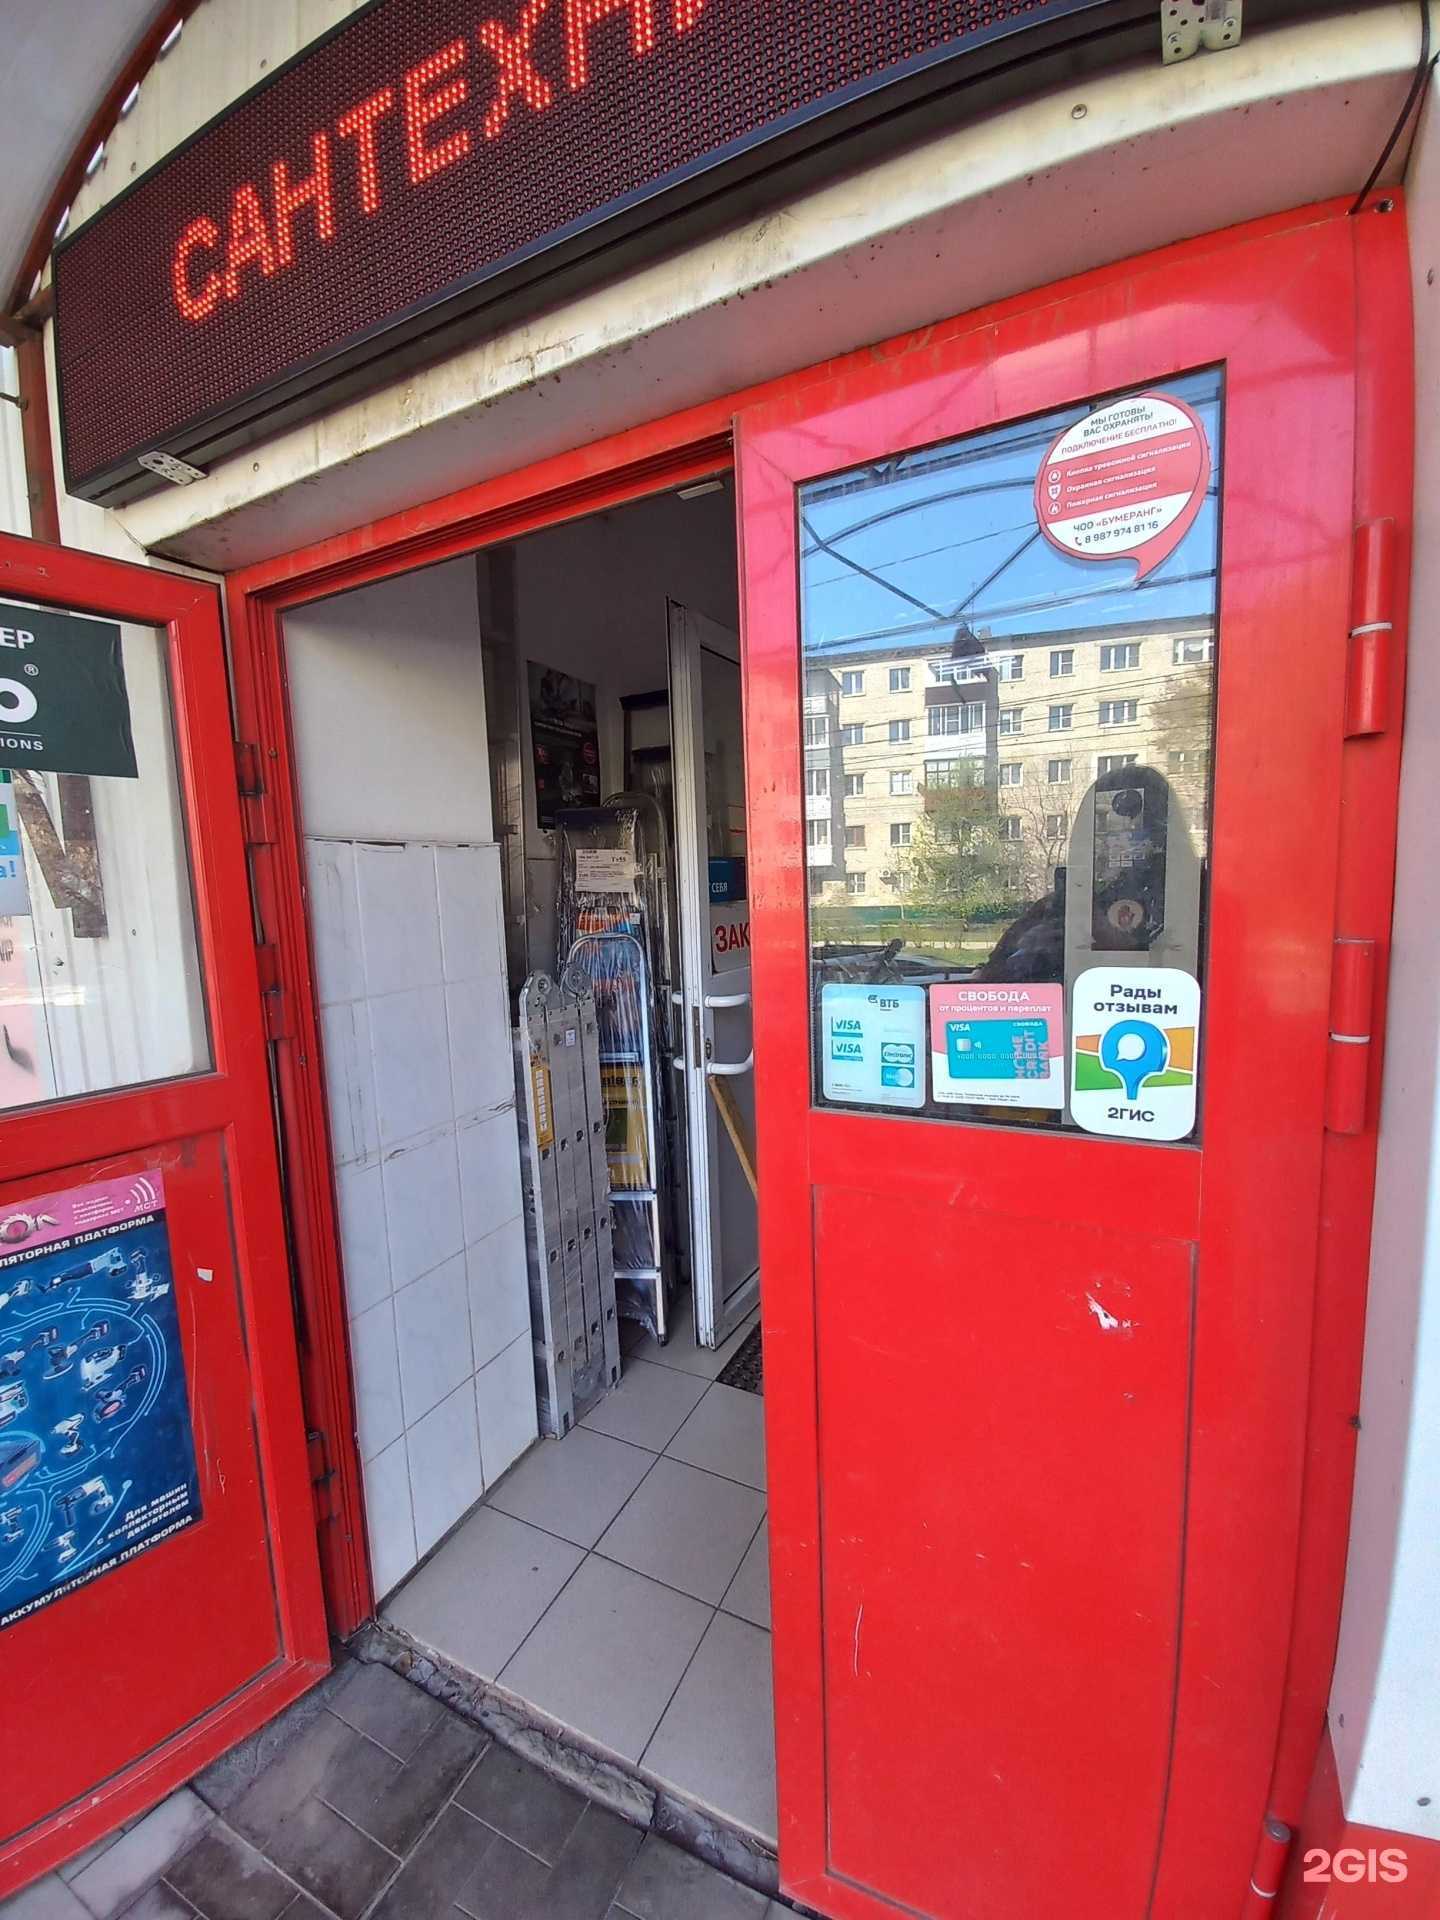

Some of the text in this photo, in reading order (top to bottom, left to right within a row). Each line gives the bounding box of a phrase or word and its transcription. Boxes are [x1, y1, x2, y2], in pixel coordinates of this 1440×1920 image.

[171, 0, 705, 323] САНТЕХН
[1083, 412, 1153, 437] ВАС ОХРАНЯТЬ!
[1090, 406, 1146, 427] МЫ ГОТОВЫ
[1061, 418, 1177, 455] ПОДКЛЮЧЕНИЕ БЕСПЛАТНО!
[1095, 507, 1163, 528] «БУМЕРАНГ»
[1085, 534, 1091, 544] 8
[1093, 530, 1112, 542] 987
[1113, 526, 1132, 537] 974
[958, 991, 1030, 1002] СВОБОДА
[1110, 984, 1162, 1000] Рады
[880, 998, 900, 1008] ВТБ
[951, 1005, 998, 1013] процентов
[1008, 1005, 1052, 1013] переплат
[1093, 1002, 1178, 1014] отзывам
[836, 1019, 862, 1031] VISA
[949, 1023, 971, 1032] VISA
[836, 1043, 862, 1054] VISA
[1107, 1107, 1155, 1122] 2ГИС
[107, 1491, 188, 1539] коллекторным
[125, 1505, 148, 1522] Для
[120, 1514, 193, 1561] ПЛАТФОРМА
